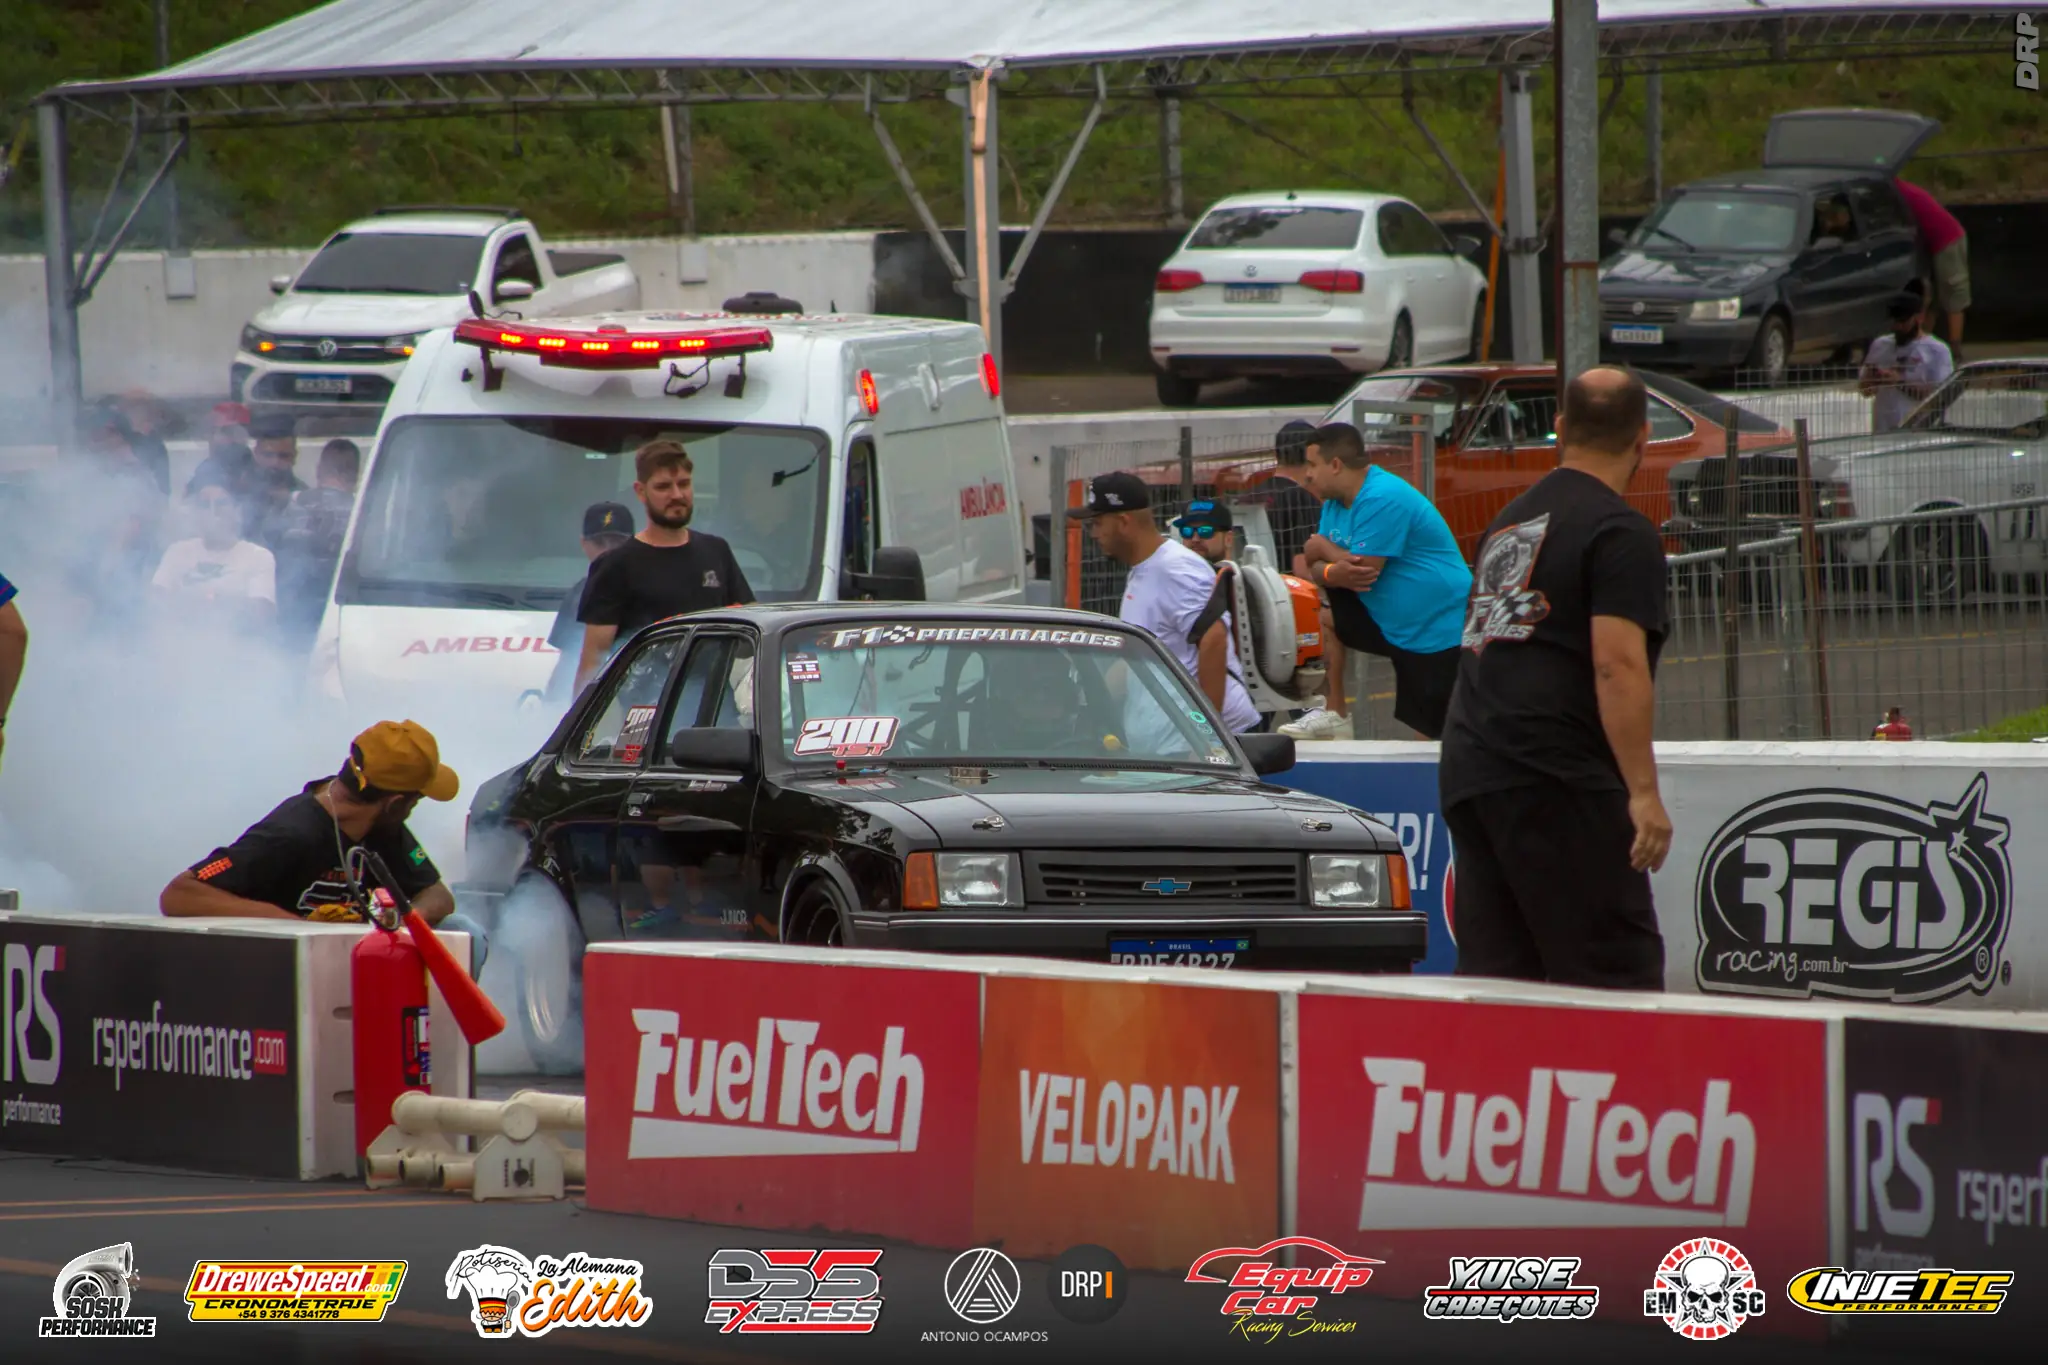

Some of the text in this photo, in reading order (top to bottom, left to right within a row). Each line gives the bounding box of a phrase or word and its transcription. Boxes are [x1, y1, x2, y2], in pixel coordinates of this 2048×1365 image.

[832, 627, 1124, 648] F1 PREPARAÇÕES
[796, 718, 897, 754] 200
[1742, 834, 1965, 951] REGIS
[3, 943, 66, 1086] RS
[3, 1094, 61, 1127] performance
[631, 1008, 924, 1152] FuelTech
[1019, 1069, 1239, 1184] VELOPARK
[1362, 1057, 1757, 1226] FuelTech
[1854, 1092, 1941, 1238] RS
